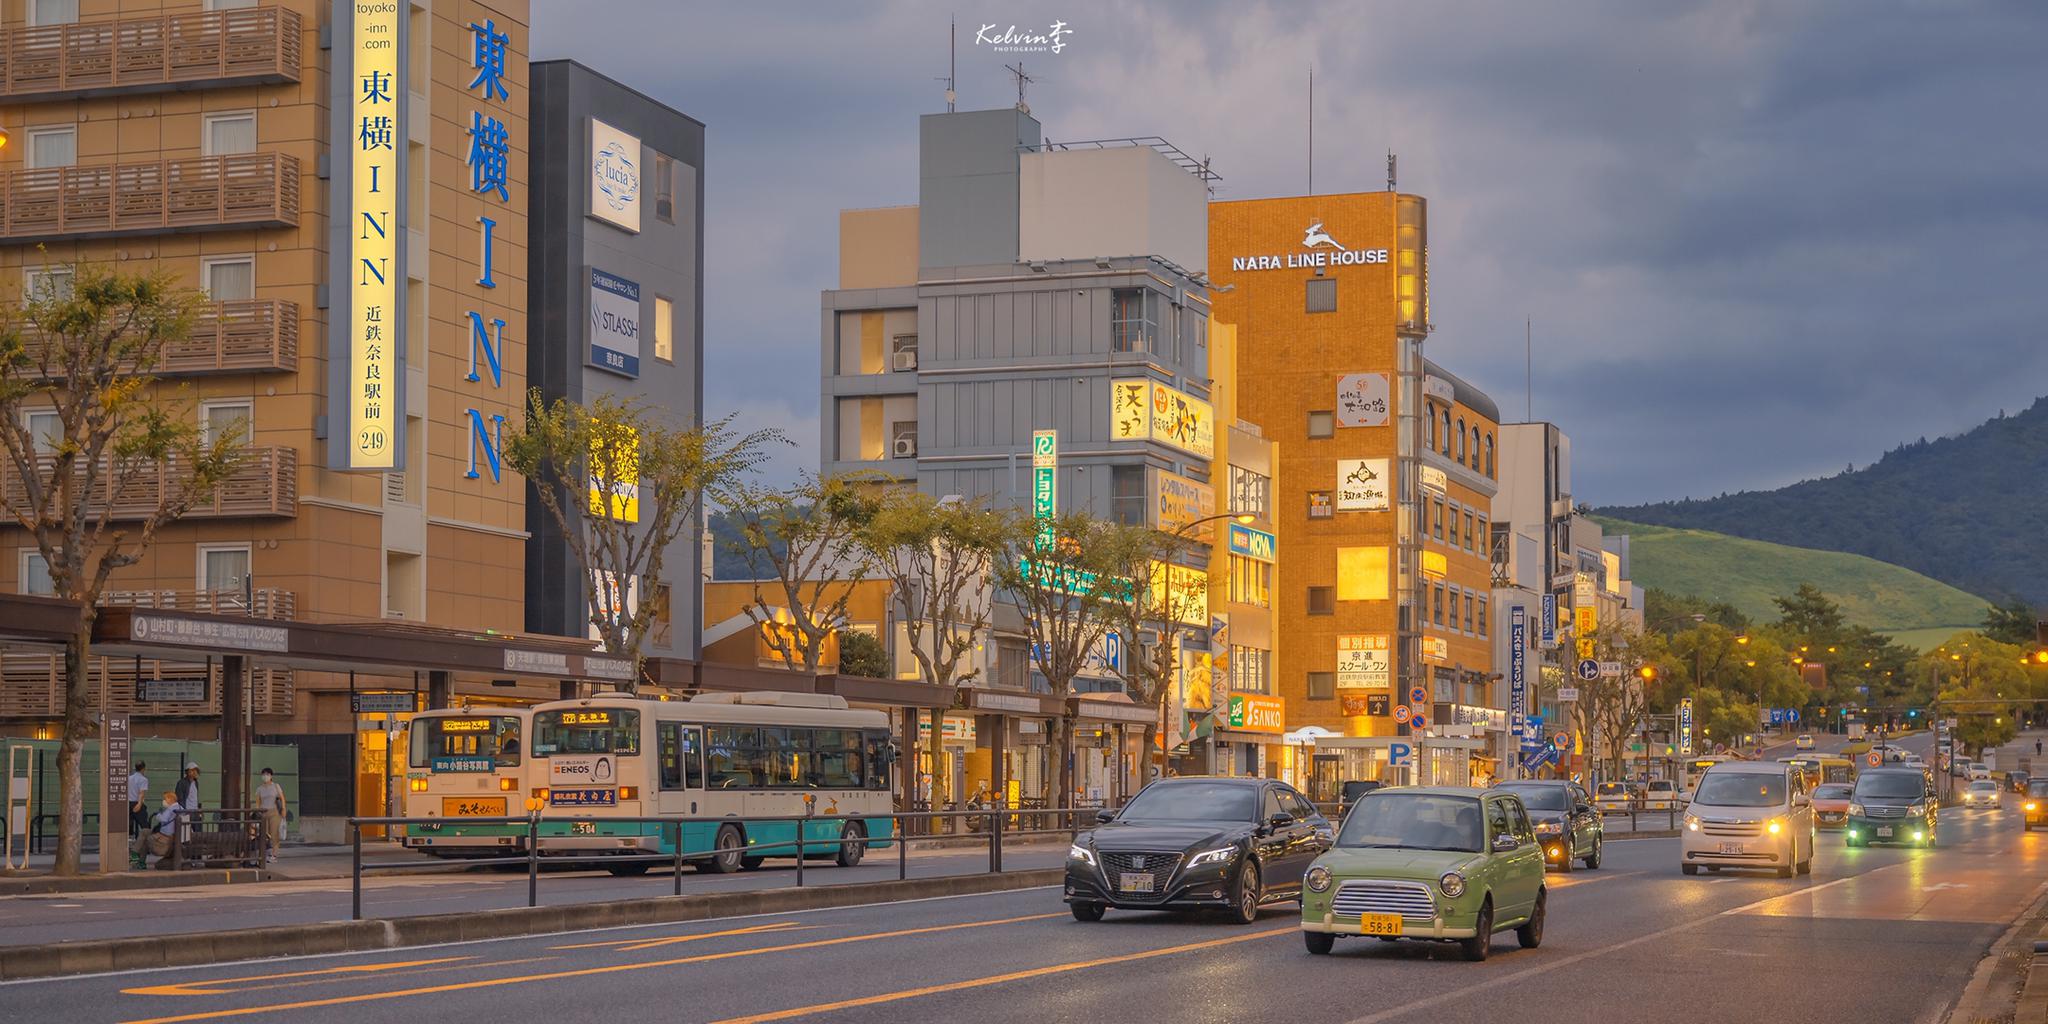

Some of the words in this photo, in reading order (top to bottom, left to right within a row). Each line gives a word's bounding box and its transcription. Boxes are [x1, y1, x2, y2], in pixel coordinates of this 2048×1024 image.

[357, 2, 396, 15] toyoko
[365, 22, 387, 33] -inn
[362, 40, 391, 49] .com
[605, 159, 628, 186] lucia
[1233, 255, 1282, 271] NARA
[1287, 252, 1326, 268] LINE
[1330, 249, 1388, 266] HOUSE
[602, 311, 639, 339] STLASSH
[364, 305, 382, 420] 近鉄奈良駅前
[360, 430, 384, 452] 249
[1249, 530, 1272, 559] NOVA
[1340, 637, 1387, 649] 個別指導
[1340, 662, 1387, 671] スクール・ワン
[121, 720, 126, 731] 4
[1253, 707, 1281, 728] SANKO
[1390, 743, 1410, 766] P
[561, 766, 590, 774] ENEOS
[1369, 921, 1398, 934] 58-81
